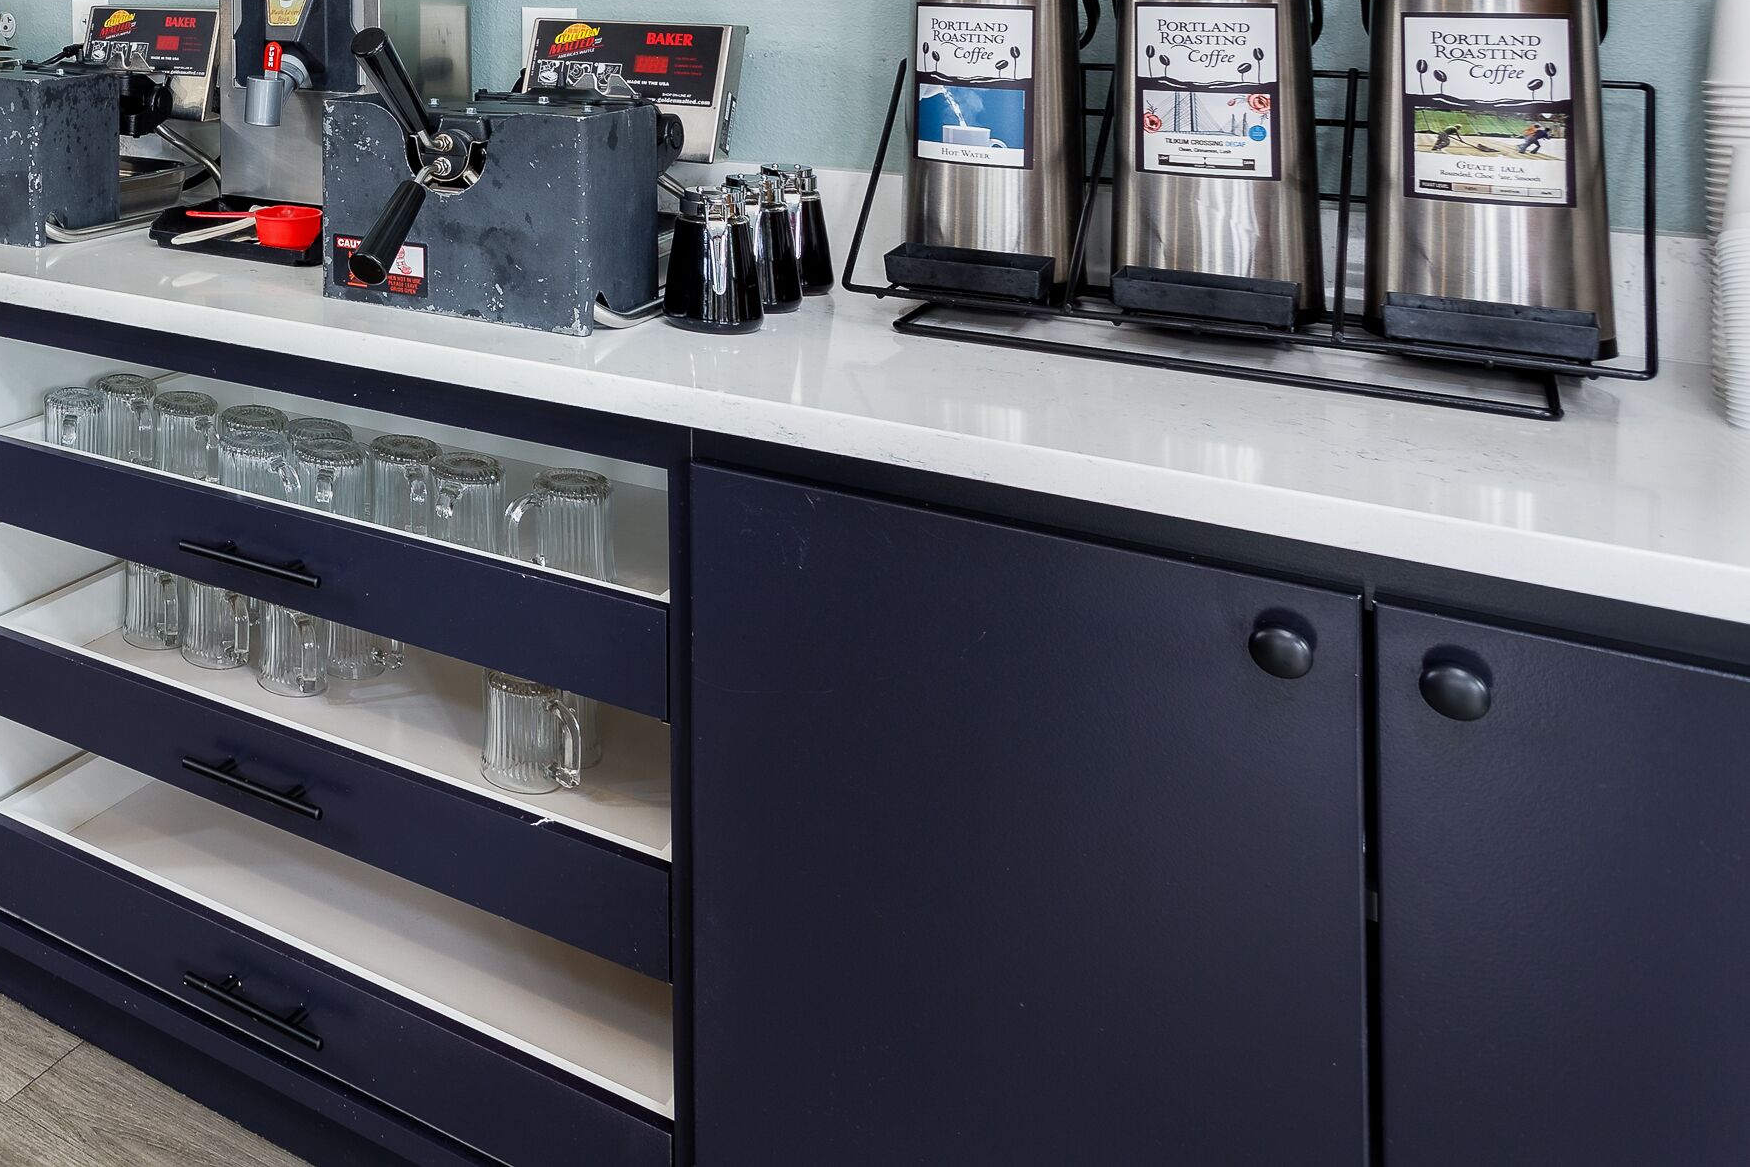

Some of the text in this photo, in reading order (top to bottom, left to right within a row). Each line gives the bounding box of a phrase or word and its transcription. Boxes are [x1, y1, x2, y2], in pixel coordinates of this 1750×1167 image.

[104, 12, 136, 28] GOLDEN
[164, 16, 197, 28] BAKER
[931, 18, 1009, 33] PORTLAND
[1156, 18, 1250, 33] PORTLAND
[554, 26, 601, 45] GOLDEN
[645, 32, 694, 47] BAKER
[933, 29, 1005, 44] ROASTING
[1160, 31, 1248, 46] ROASTING
[1430, 30, 1541, 47] PORTLAND
[549, 36, 595, 55] MALTED
[1433, 44, 1538, 60] ROASTING
[267, 45, 276, 68] PUSH
[953, 46, 994, 64] Coffee
[1187, 49, 1236, 68] Coffee
[1468, 64, 1525, 85] Coffee
[1190, 139, 1224, 147] CROSSING
[1514, 174, 1541, 182] Smooth
